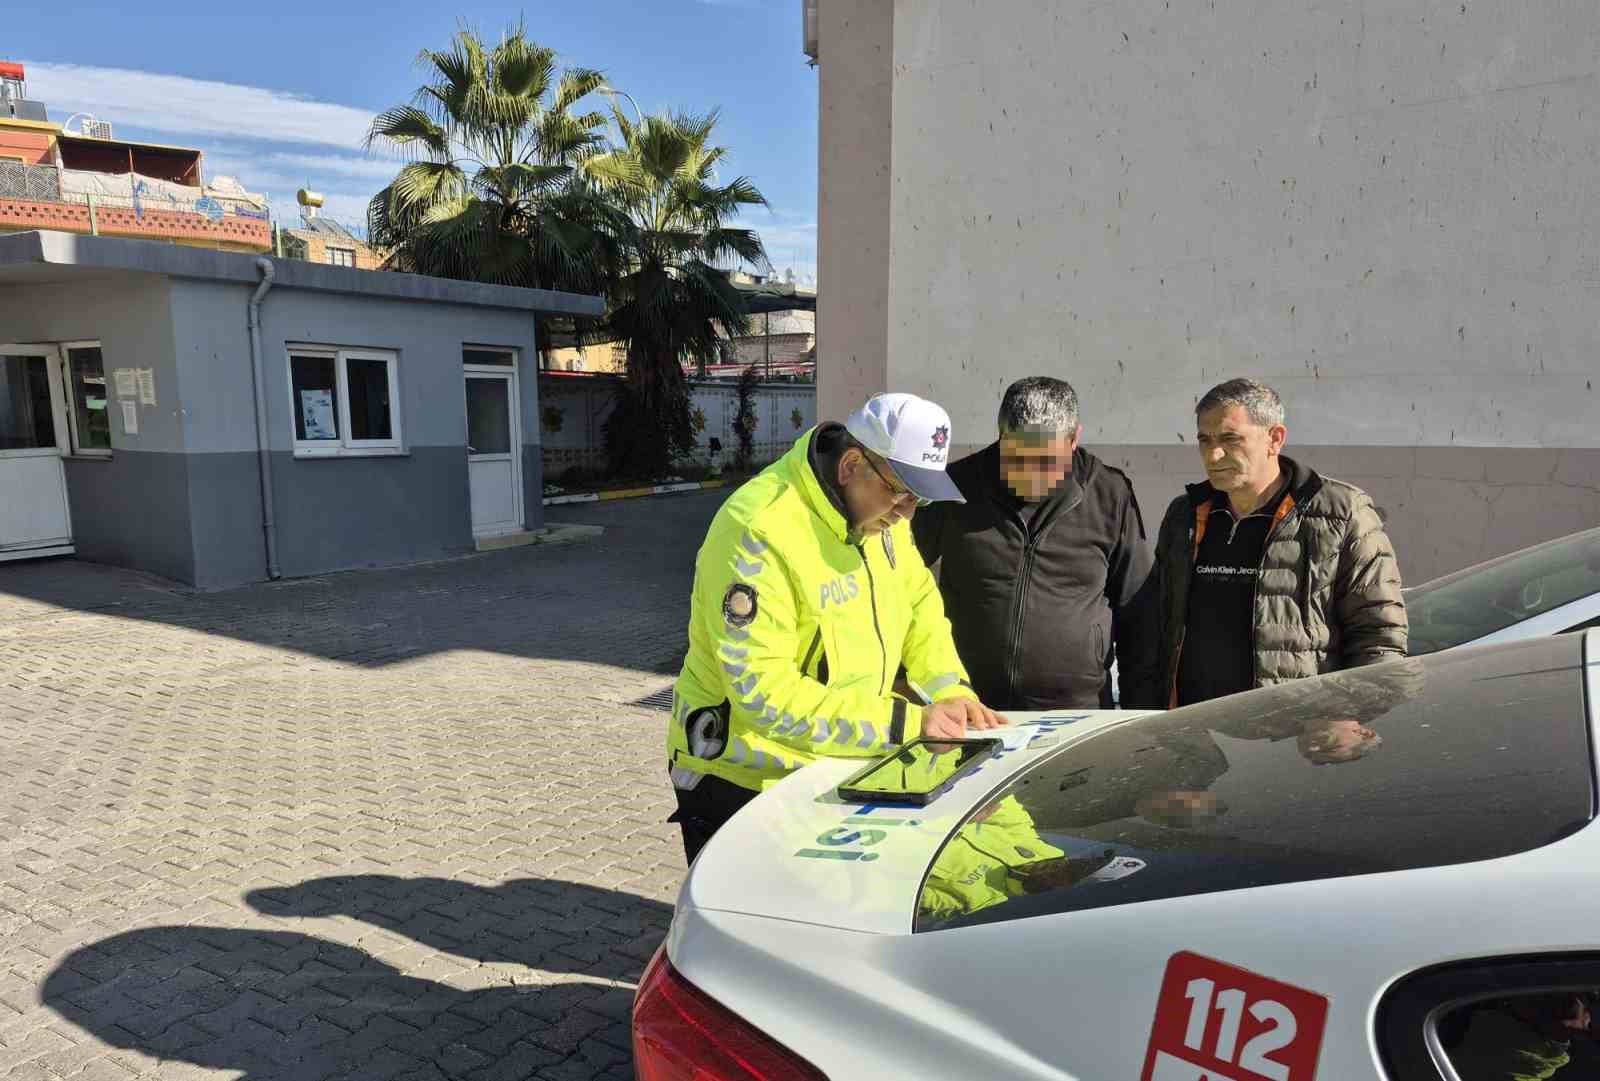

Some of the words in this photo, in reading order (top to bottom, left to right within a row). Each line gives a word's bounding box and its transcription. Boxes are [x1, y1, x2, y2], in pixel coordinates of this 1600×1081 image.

[921, 453, 946, 463] POL
[1196, 565, 1217, 575] Calvin
[1217, 566, 1237, 575] Klein
[1237, 566, 1258, 576] Jean
[820, 574, 859, 609] POLS
[1184, 977, 1297, 1081] 112
